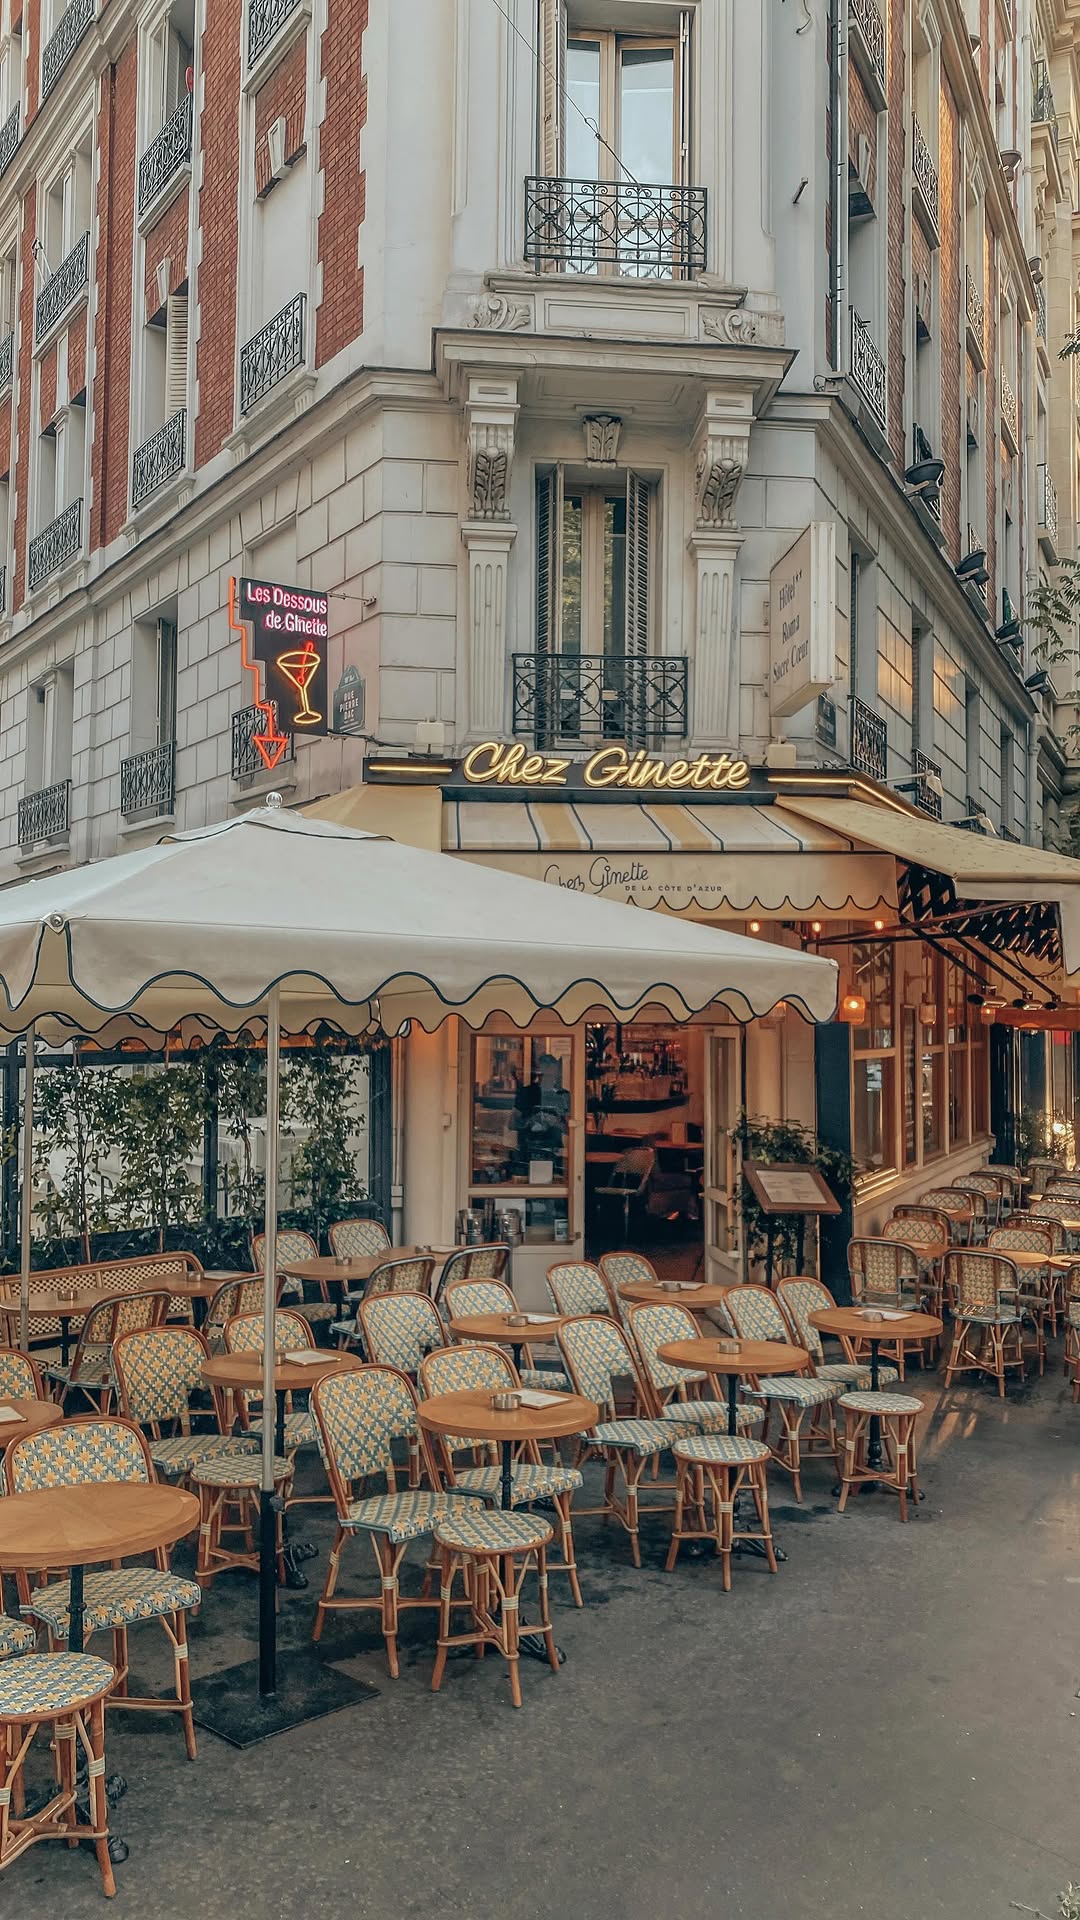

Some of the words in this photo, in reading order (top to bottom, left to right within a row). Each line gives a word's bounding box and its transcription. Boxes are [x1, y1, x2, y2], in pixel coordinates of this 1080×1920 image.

[247, 581, 271, 604] Les
[271, 585, 327, 614] Dessous
[779, 575, 796, 611] Hôtel
[265, 610, 282, 630] de
[285, 613, 328, 637] Ginette
[782, 615, 799, 644] Roma
[339, 697, 359, 713] PIERRE
[343, 690, 355, 702] RUE
[463, 741, 573, 785] Chez
[583, 746, 750, 790] Ginette
[589, 856, 649, 895] Ginette
[658, 883, 682, 892] CÔTE
[687, 883, 722, 892] D'AZUR
